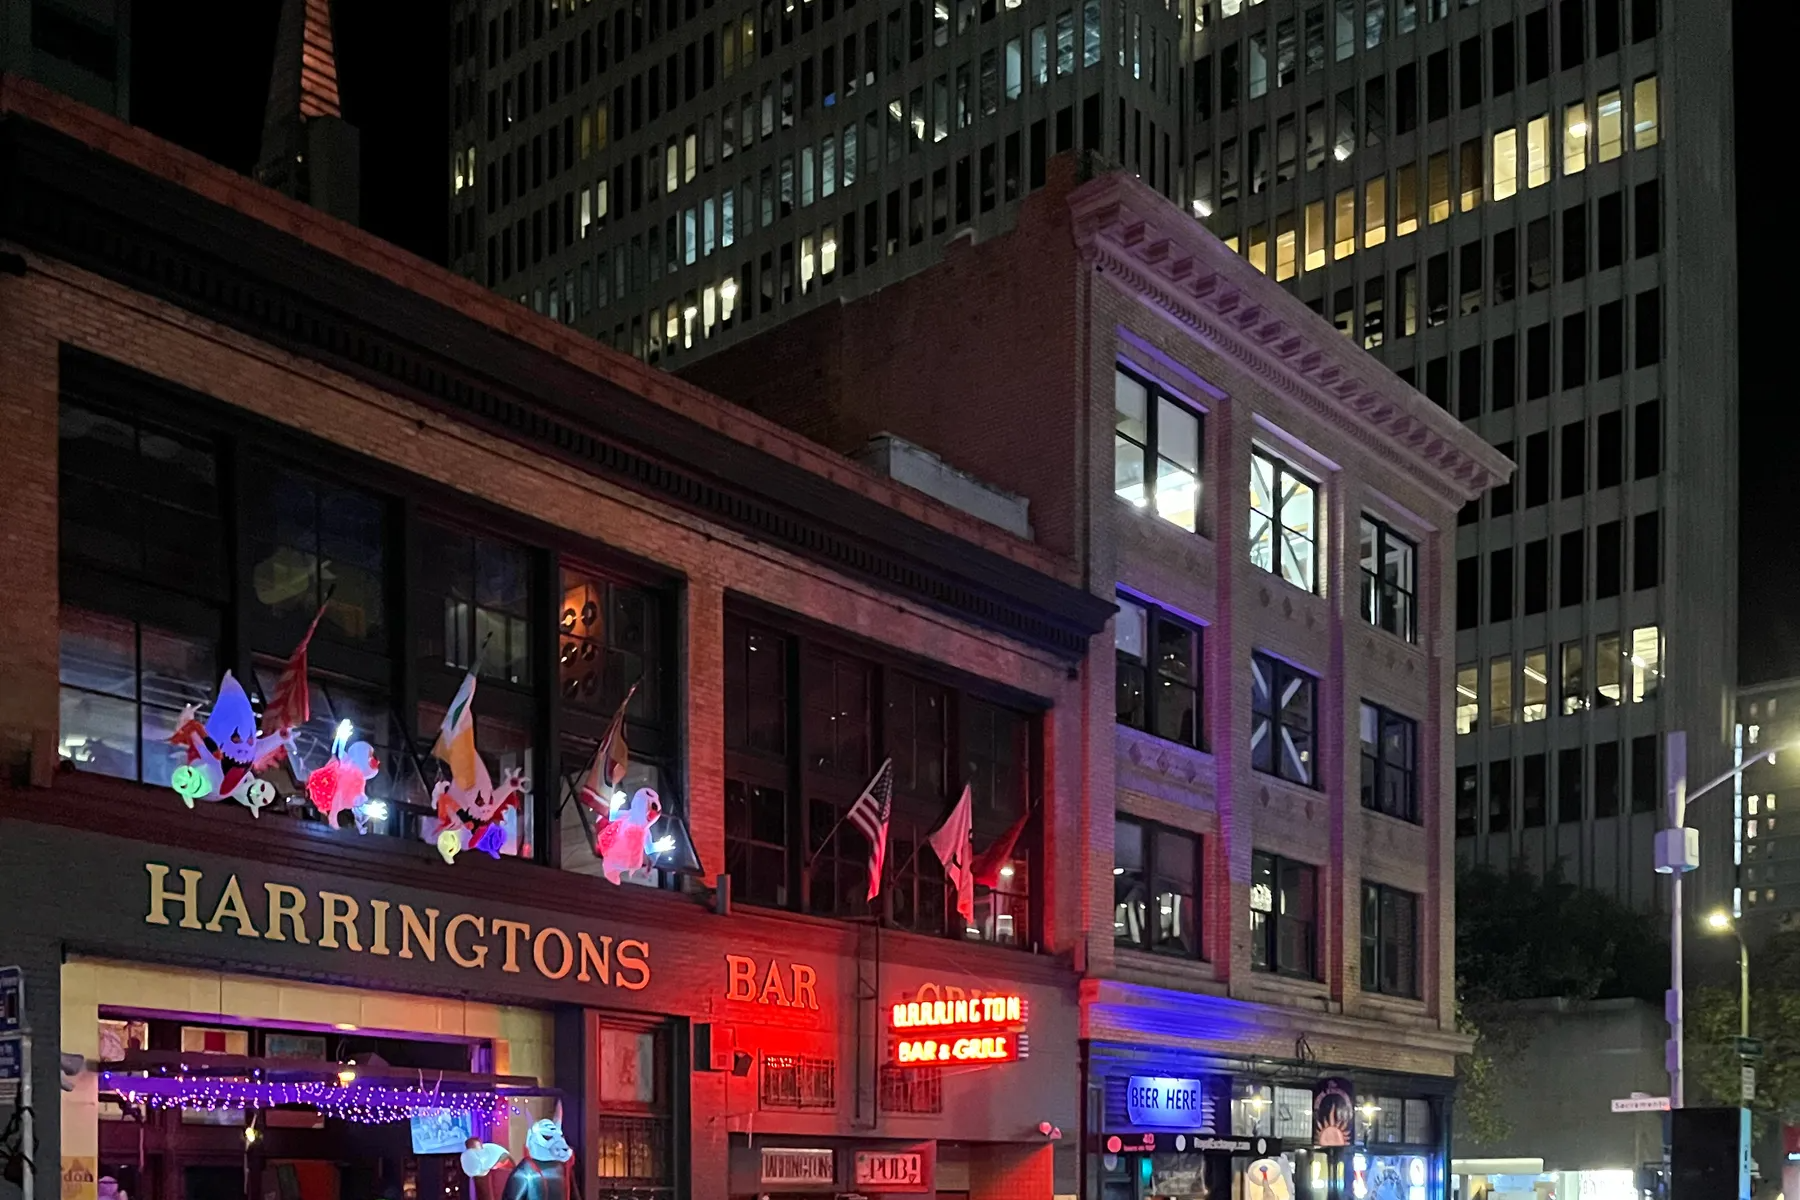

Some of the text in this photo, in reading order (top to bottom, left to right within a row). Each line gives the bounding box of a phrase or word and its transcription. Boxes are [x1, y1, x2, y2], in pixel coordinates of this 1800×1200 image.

[145, 863, 651, 990] HARRINGTONS
[726, 954, 819, 1010] BAR
[898, 1037, 1007, 1062] BAR & GRILL
[1131, 1087, 1197, 1110] BEER HERE
[869, 1157, 908, 1179] PUB
